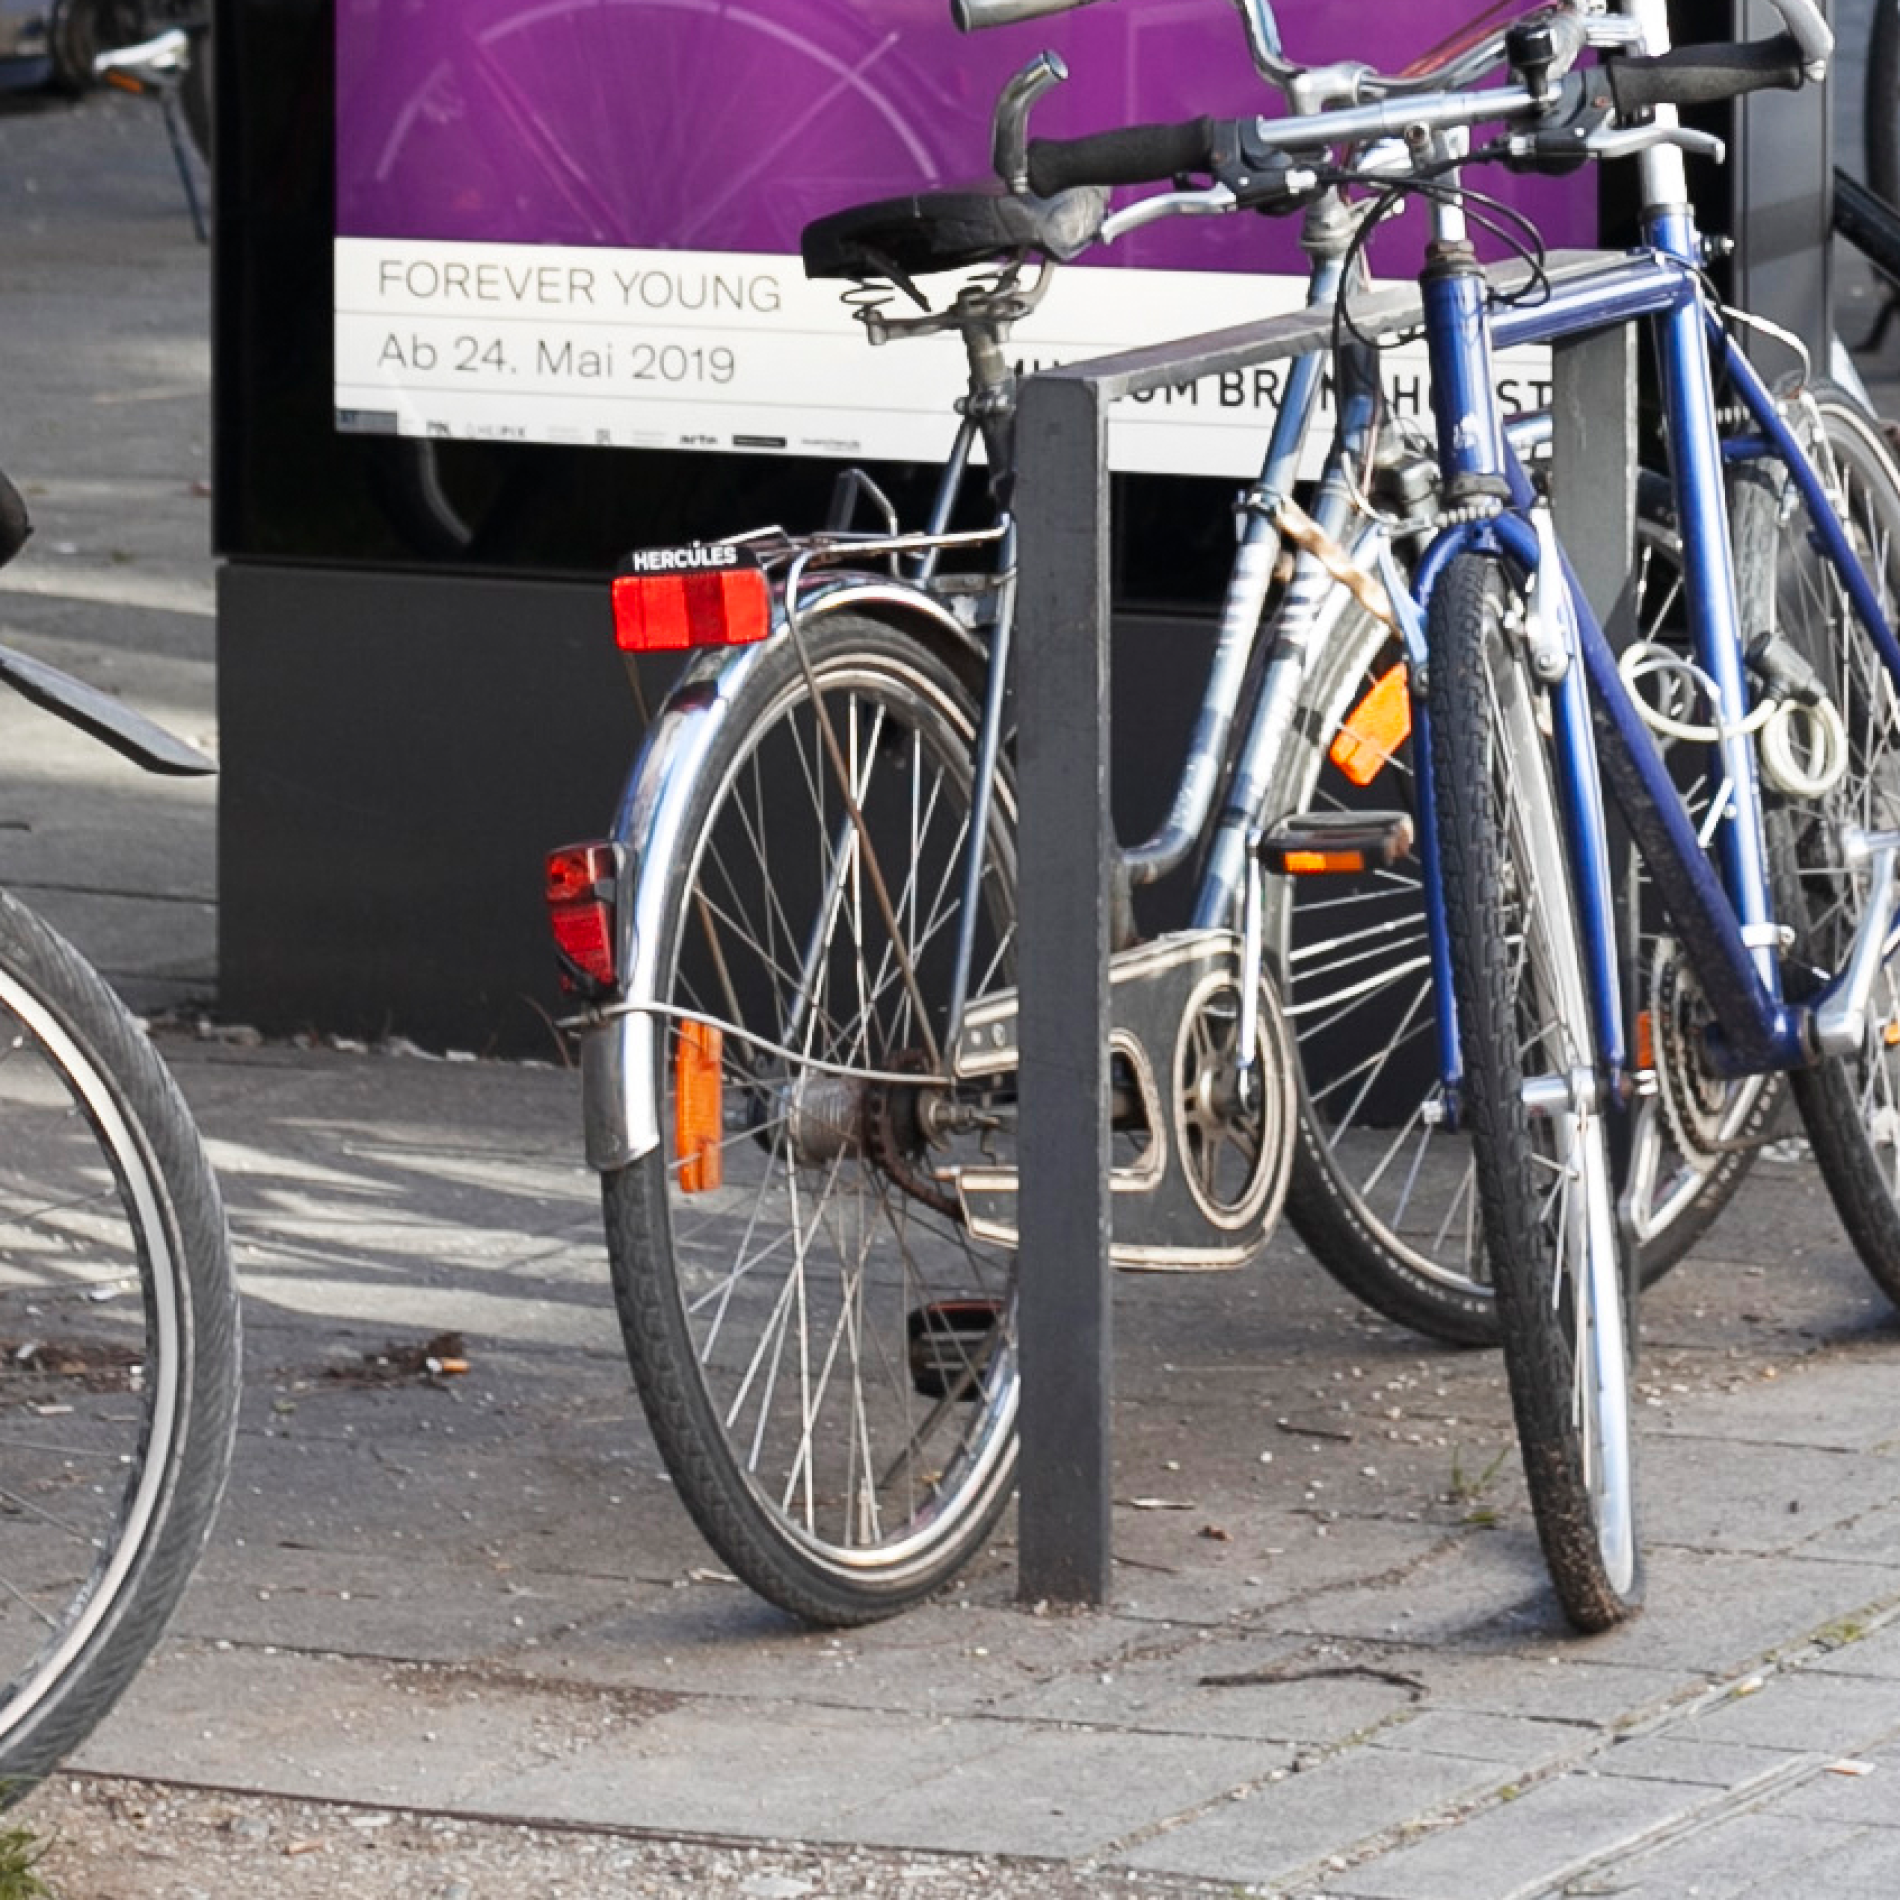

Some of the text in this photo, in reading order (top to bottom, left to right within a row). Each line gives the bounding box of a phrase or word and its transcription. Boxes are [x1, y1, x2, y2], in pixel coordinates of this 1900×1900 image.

[379, 259, 781, 312] FOREVER YOUNG
[377, 332, 736, 384] Ab 24. Mai 2019
[632, 546, 738, 572] HERCULES
